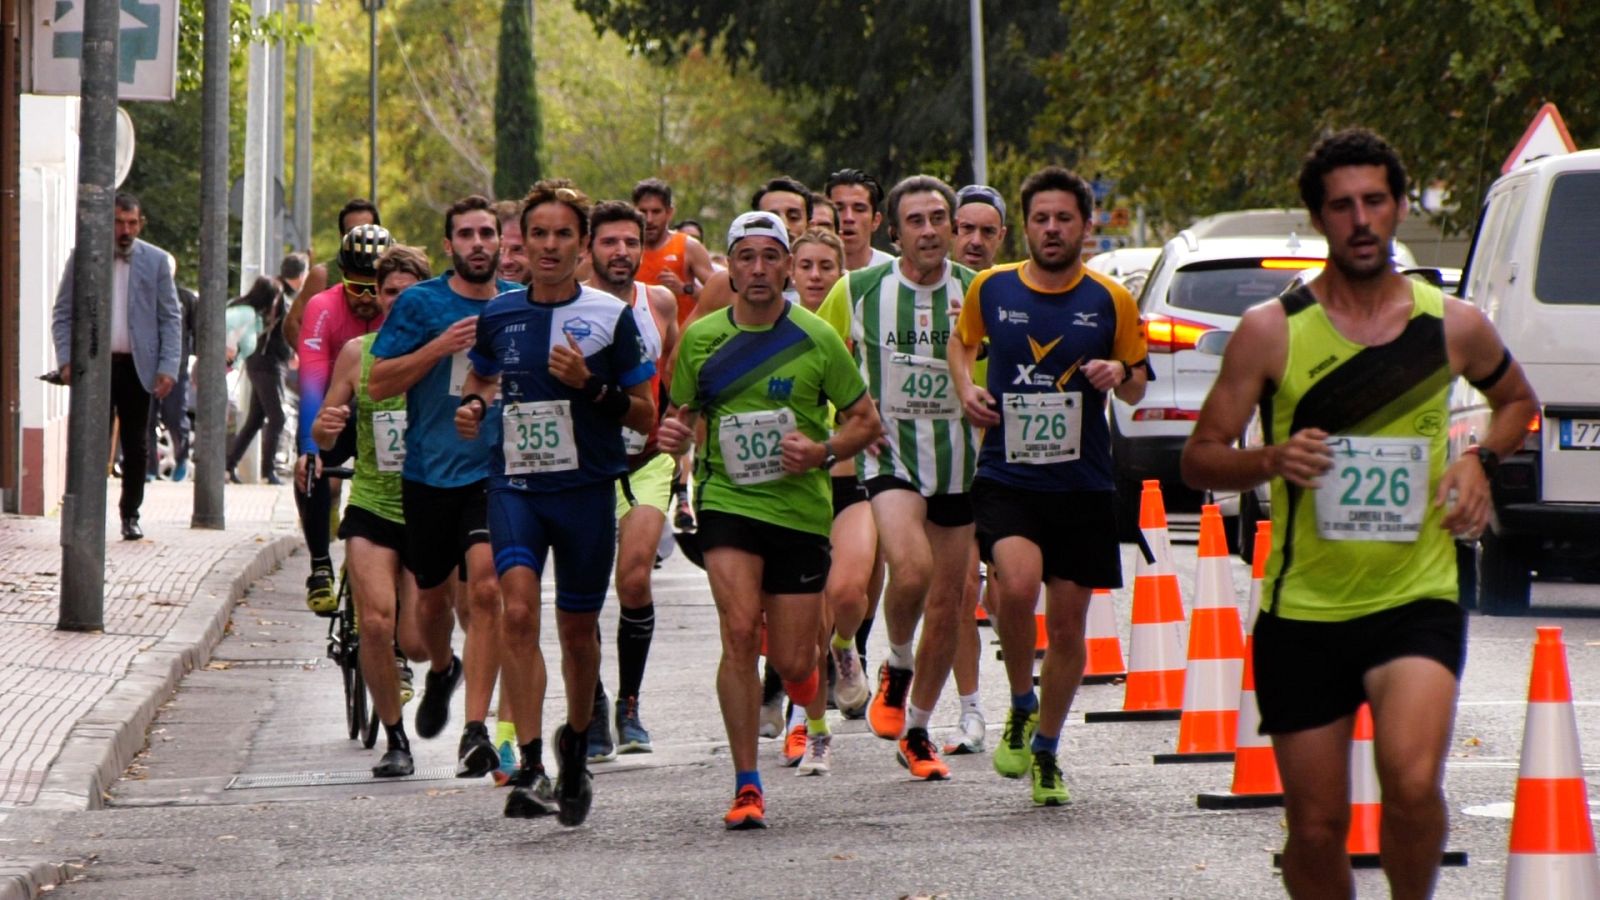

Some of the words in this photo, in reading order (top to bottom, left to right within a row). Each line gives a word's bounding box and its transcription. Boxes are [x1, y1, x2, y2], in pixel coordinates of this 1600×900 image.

[901, 372, 949, 399] 492
[517, 421, 560, 450] 355
[1018, 413, 1066, 440] 726
[1577, 423, 1600, 443] 77
[735, 429, 782, 461] 362
[1339, 466, 1410, 507] 226
